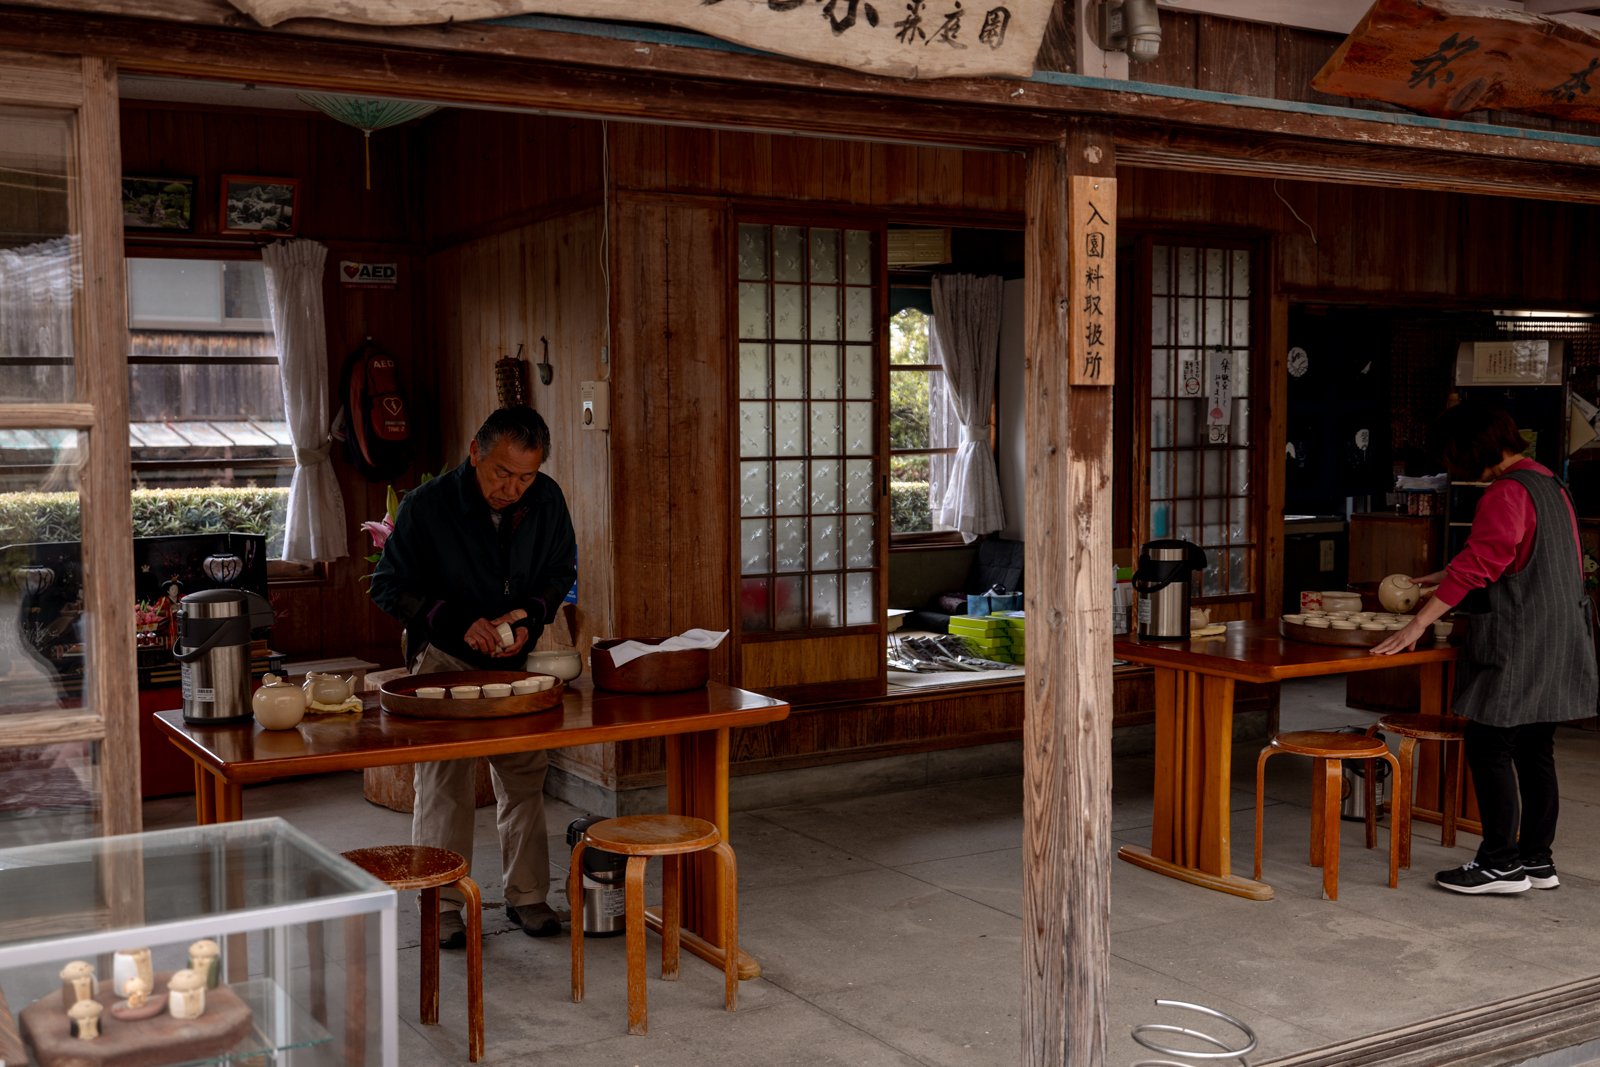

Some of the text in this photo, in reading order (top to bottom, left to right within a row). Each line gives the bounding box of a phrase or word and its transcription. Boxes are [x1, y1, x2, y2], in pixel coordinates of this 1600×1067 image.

[359, 265, 396, 278] AED
[1083, 201, 1109, 378] 入園料取扱所
[373, 360, 395, 369] AED
